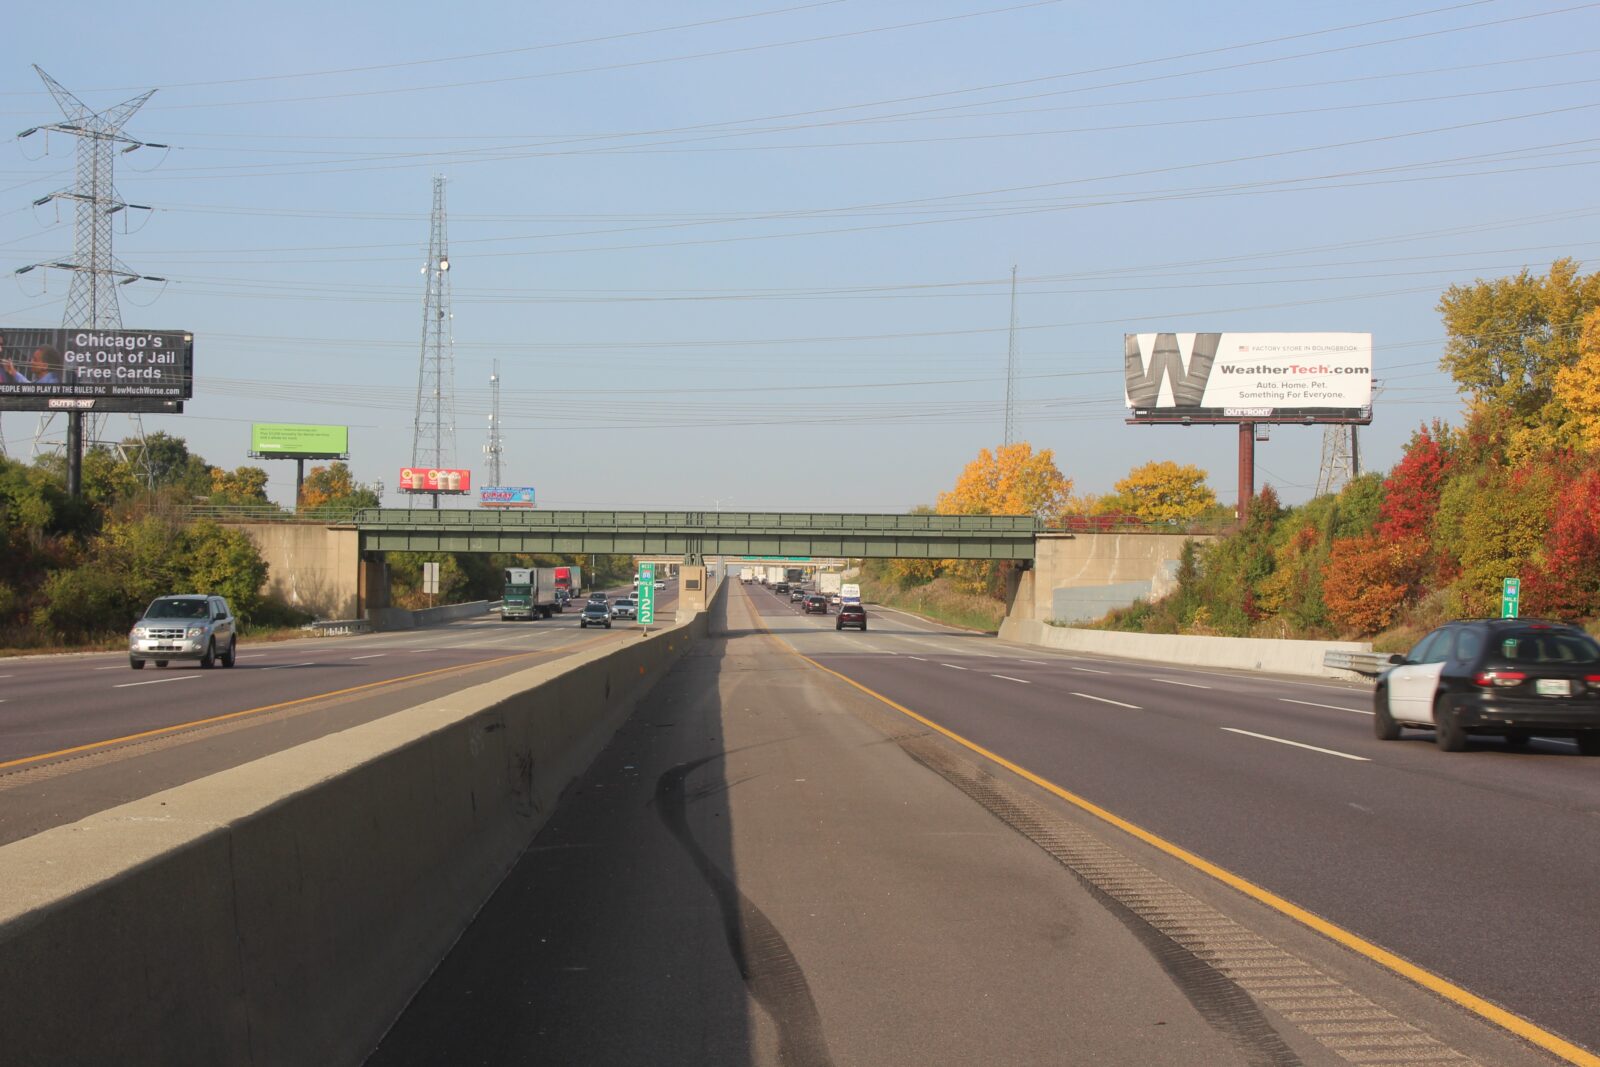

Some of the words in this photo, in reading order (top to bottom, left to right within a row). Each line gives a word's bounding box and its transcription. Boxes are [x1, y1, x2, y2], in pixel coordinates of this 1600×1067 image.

[75, 333, 163, 350] Chicago's
[64, 351, 91, 363] Get
[95, 351, 123, 363] Out
[128, 351, 144, 363] of
[148, 351, 175, 364] Jail
[77, 366, 111, 378] Free
[116, 366, 161, 378] Cards
[1220, 364, 1370, 375] WeatherTech.com
[22, 385, 35, 393] WHO
[74, 386, 94, 394] RULES
[94, 386, 106, 394] PAC
[1256, 381, 1279, 389] Auto.
[1281, 381, 1309, 389] Home.
[1311, 381, 1327, 389] Pet.
[1239, 391, 1284, 400] Something
[1286, 391, 1300, 399] For
[1303, 391, 1345, 400] Everyone.
